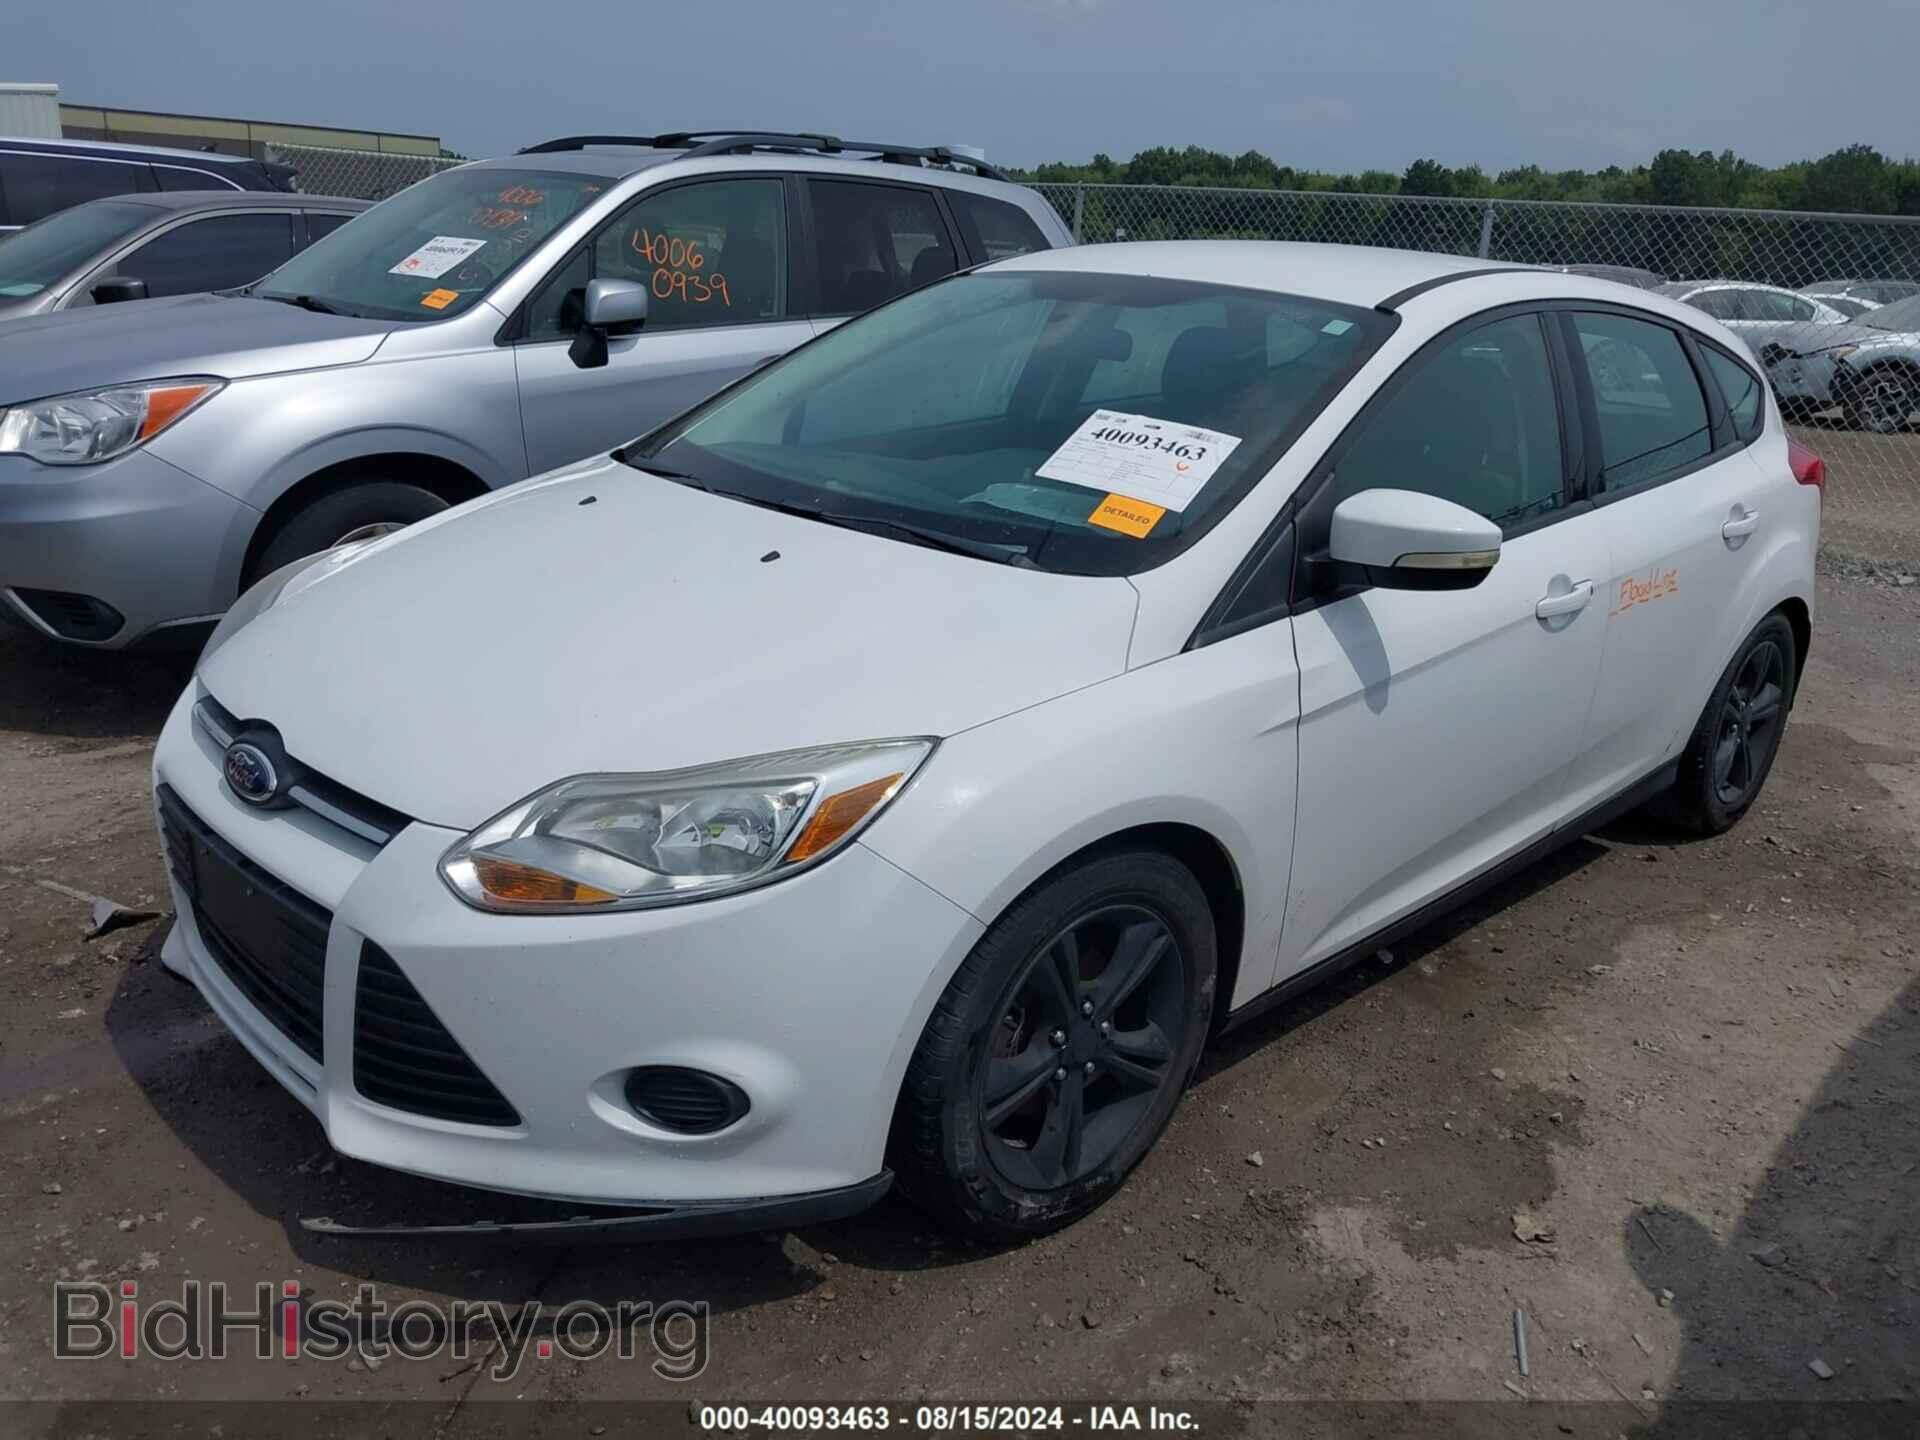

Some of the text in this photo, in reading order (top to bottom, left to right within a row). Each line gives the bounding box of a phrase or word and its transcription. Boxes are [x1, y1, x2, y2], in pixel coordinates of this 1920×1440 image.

[632, 229, 704, 269] 4006
[652, 268, 730, 306] 0939
[1091, 426, 1207, 461] 40093463
[228, 750, 260, 790] Ford
